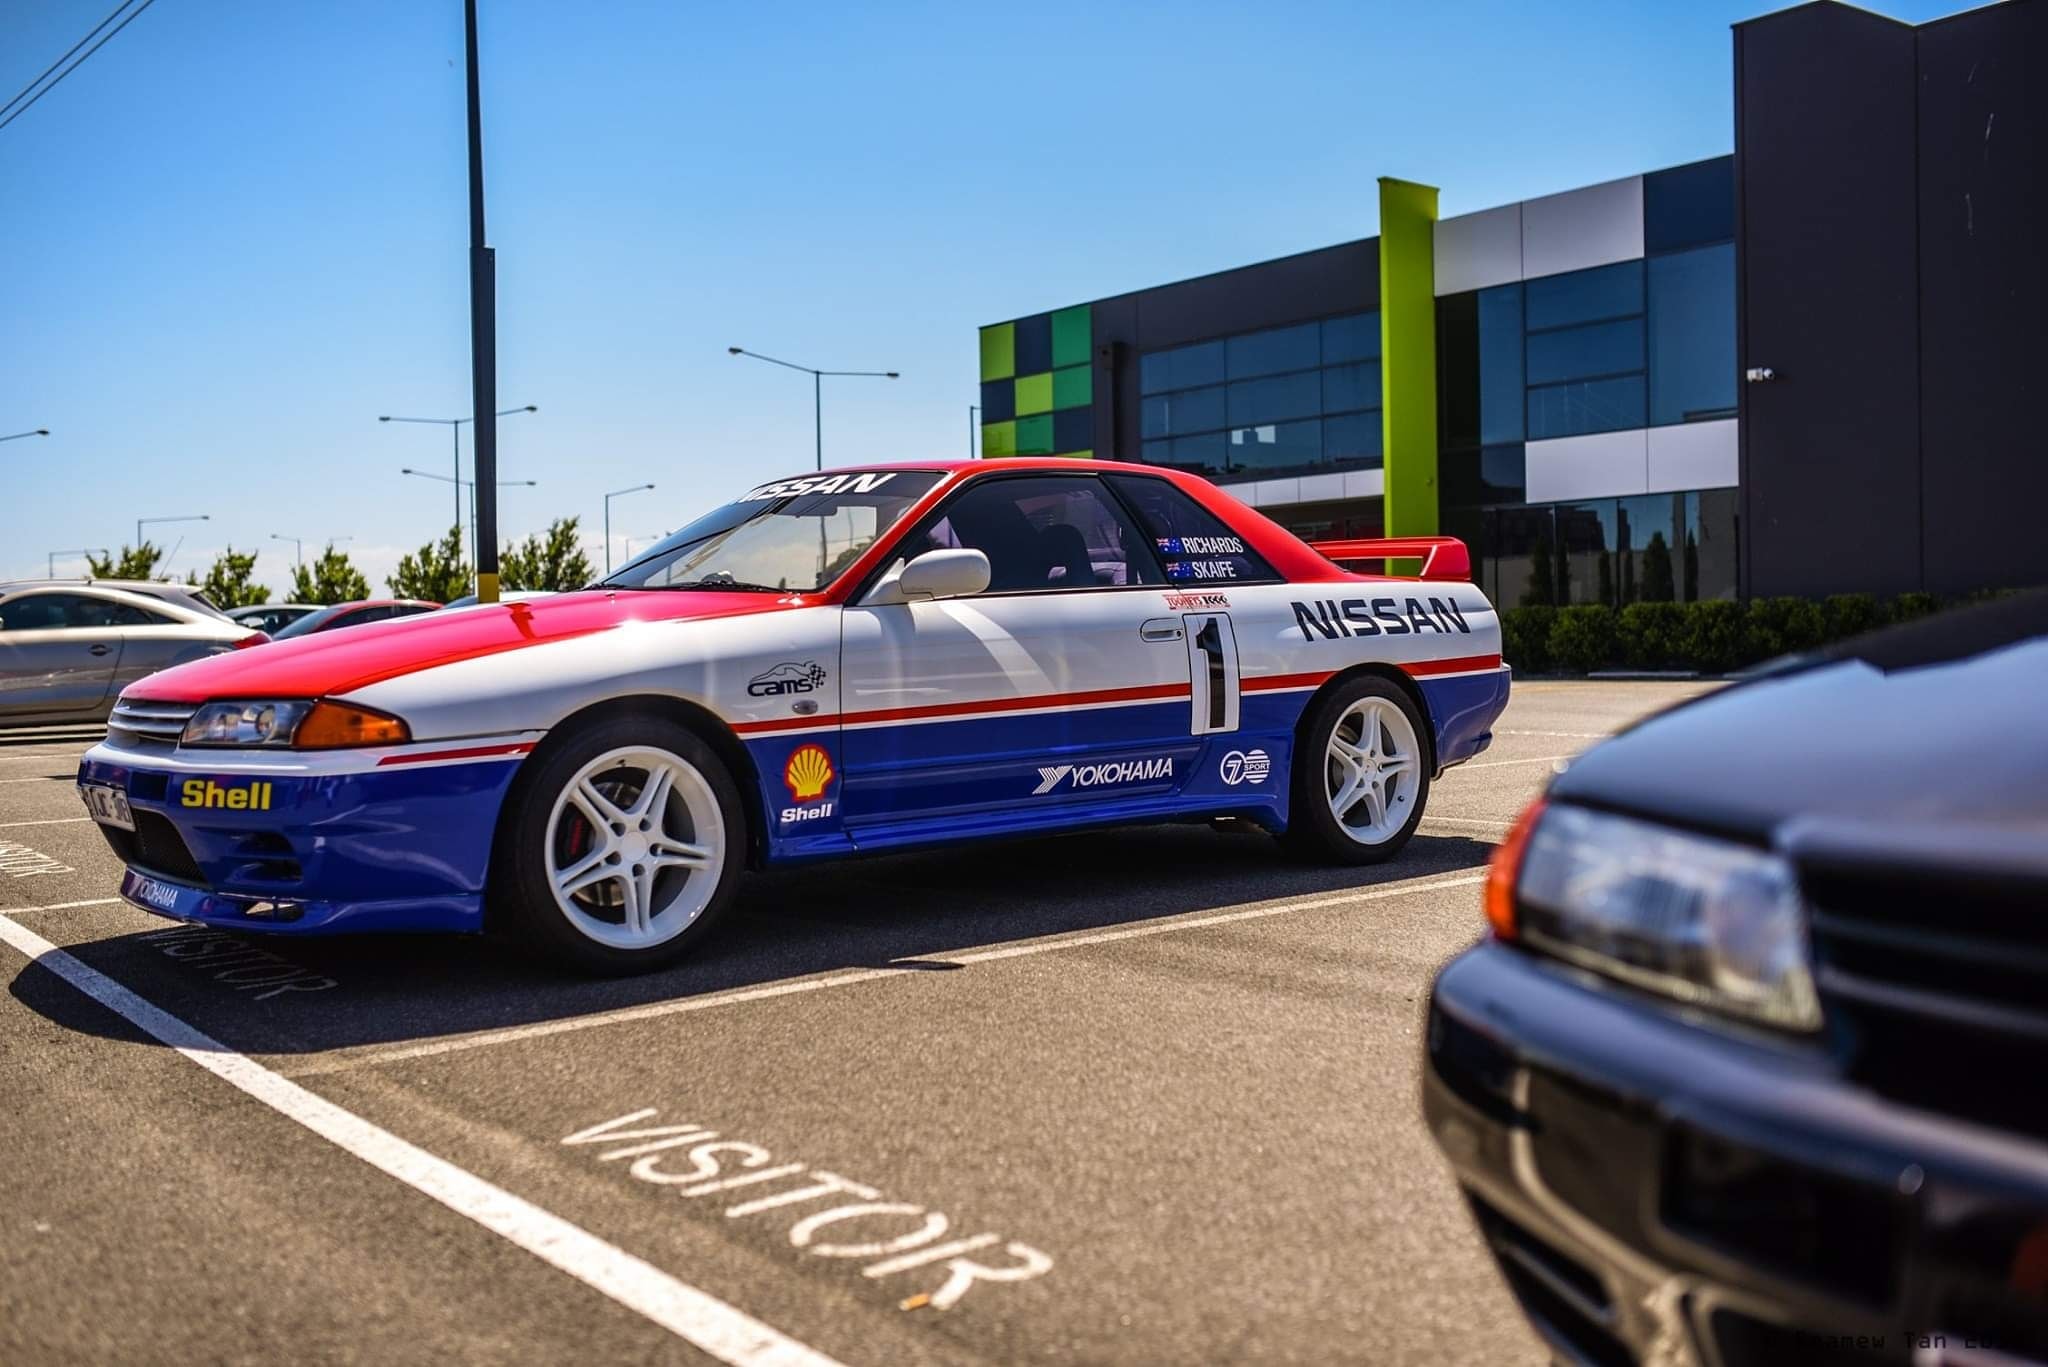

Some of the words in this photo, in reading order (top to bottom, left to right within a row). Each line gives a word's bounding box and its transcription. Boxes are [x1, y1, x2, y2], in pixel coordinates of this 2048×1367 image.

[1181, 536, 1244, 554] RICHARDS
[1191, 560, 1237, 578] SKAIFE
[1290, 597, 1471, 642] NISSAN
[1196, 617, 1226, 729] 1
[1071, 757, 1173, 788] YOKOHAMA
[1244, 763, 1270, 772] SPORT
[181, 779, 272, 810] Shell
[780, 803, 832, 823] Shell
[138, 925, 339, 1001] VISITOR
[560, 1107, 1054, 1310] VISITOR
